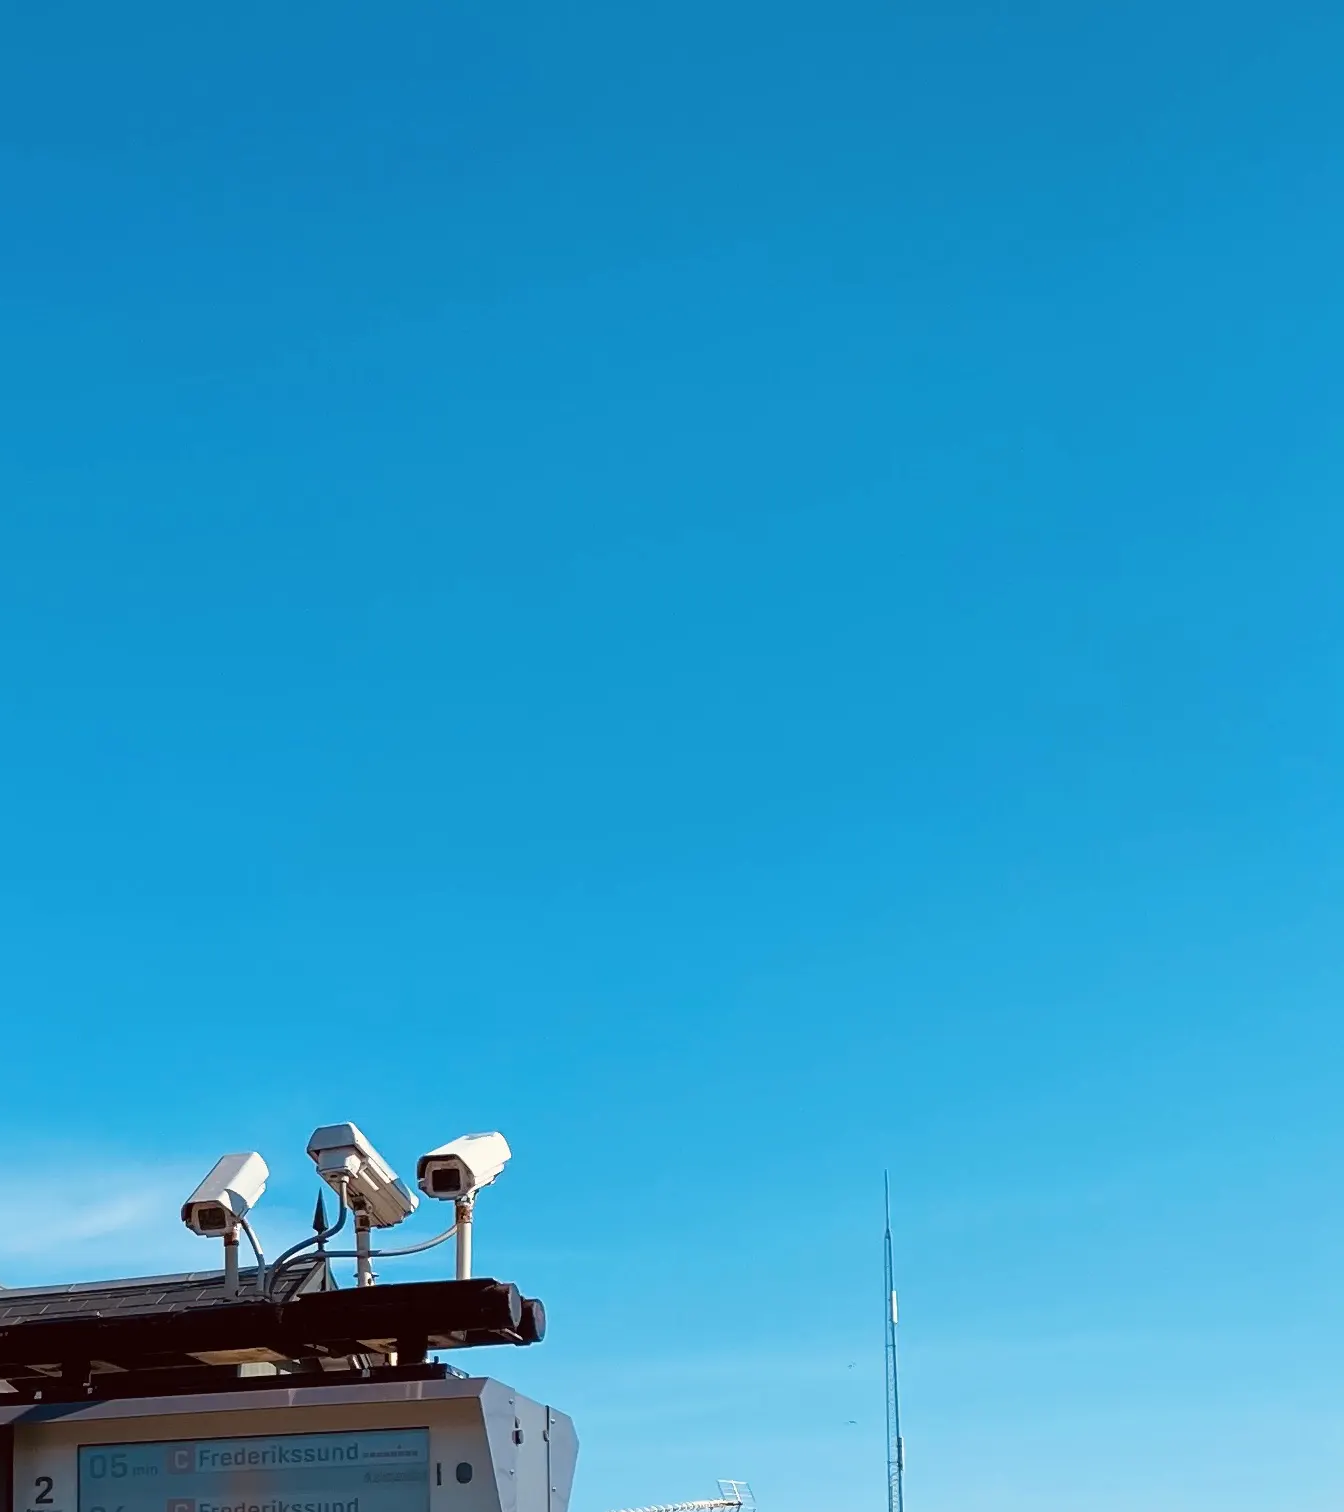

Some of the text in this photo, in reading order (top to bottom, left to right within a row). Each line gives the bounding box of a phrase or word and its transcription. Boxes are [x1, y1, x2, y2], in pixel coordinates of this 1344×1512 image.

[89, 1442, 359, 1479] 05 min C Frederikssund
[34, 1476, 54, 1504] 2
